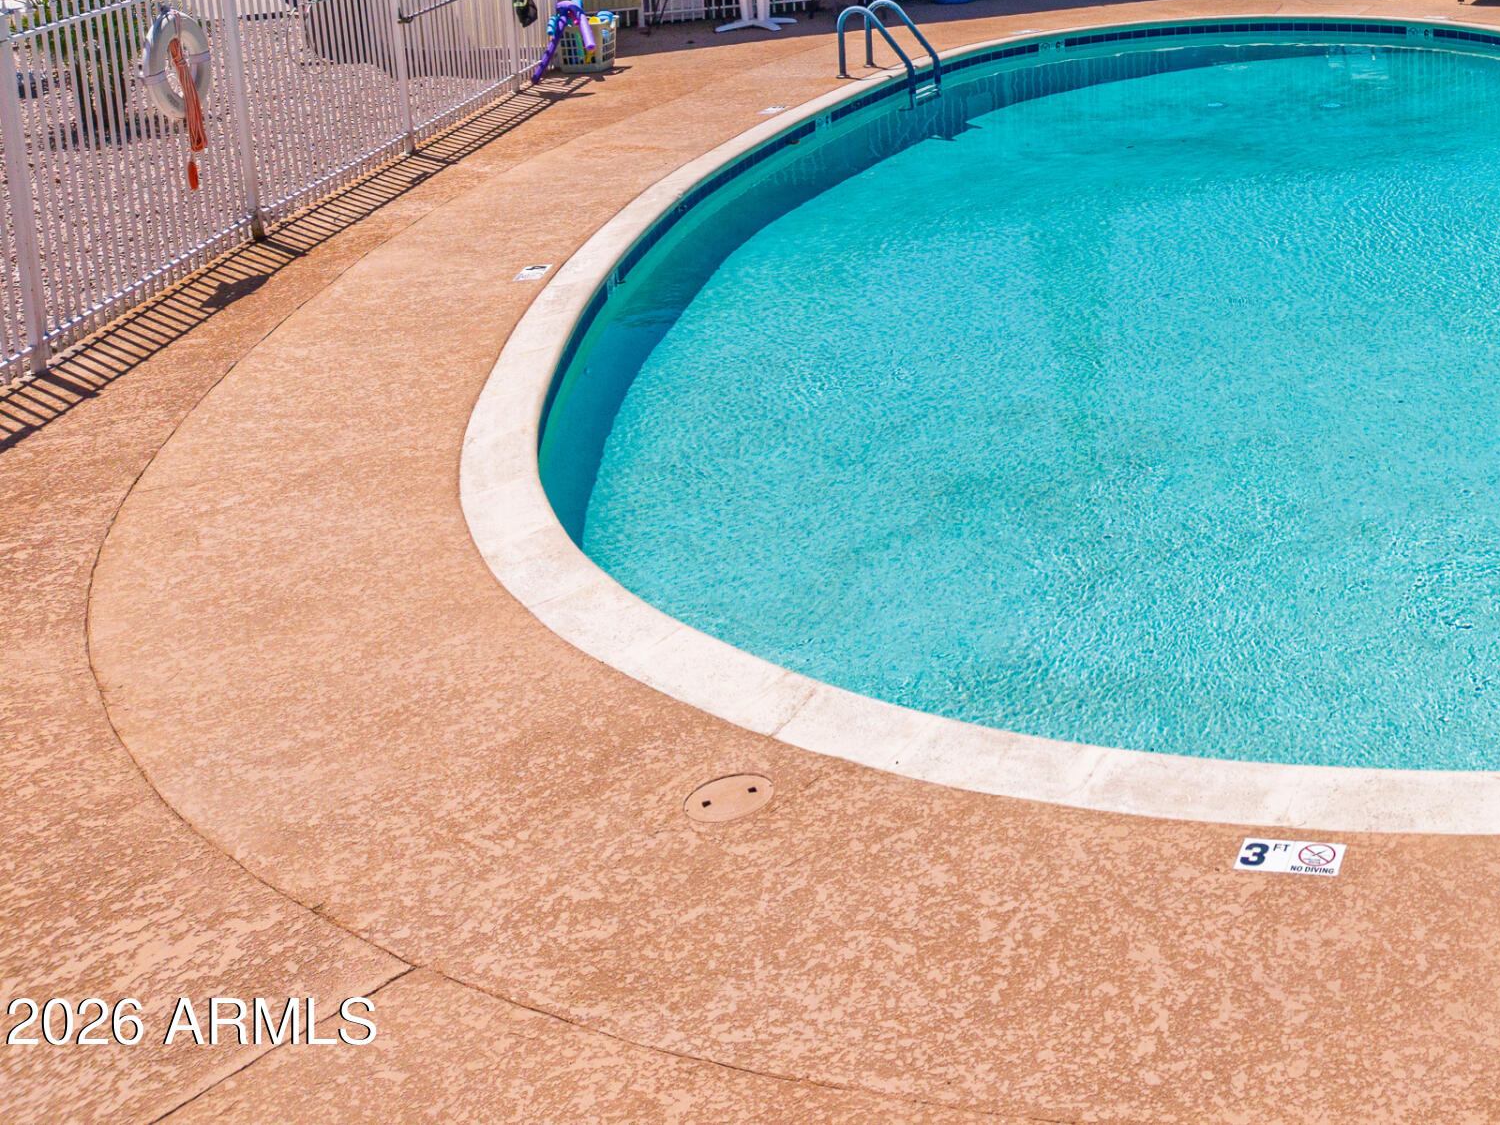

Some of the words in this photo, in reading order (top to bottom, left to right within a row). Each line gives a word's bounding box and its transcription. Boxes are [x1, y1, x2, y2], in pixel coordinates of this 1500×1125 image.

[1239, 842, 1270, 866] 3
[1272, 843, 1291, 852] FT
[1304, 866, 1335, 874] DIVING
